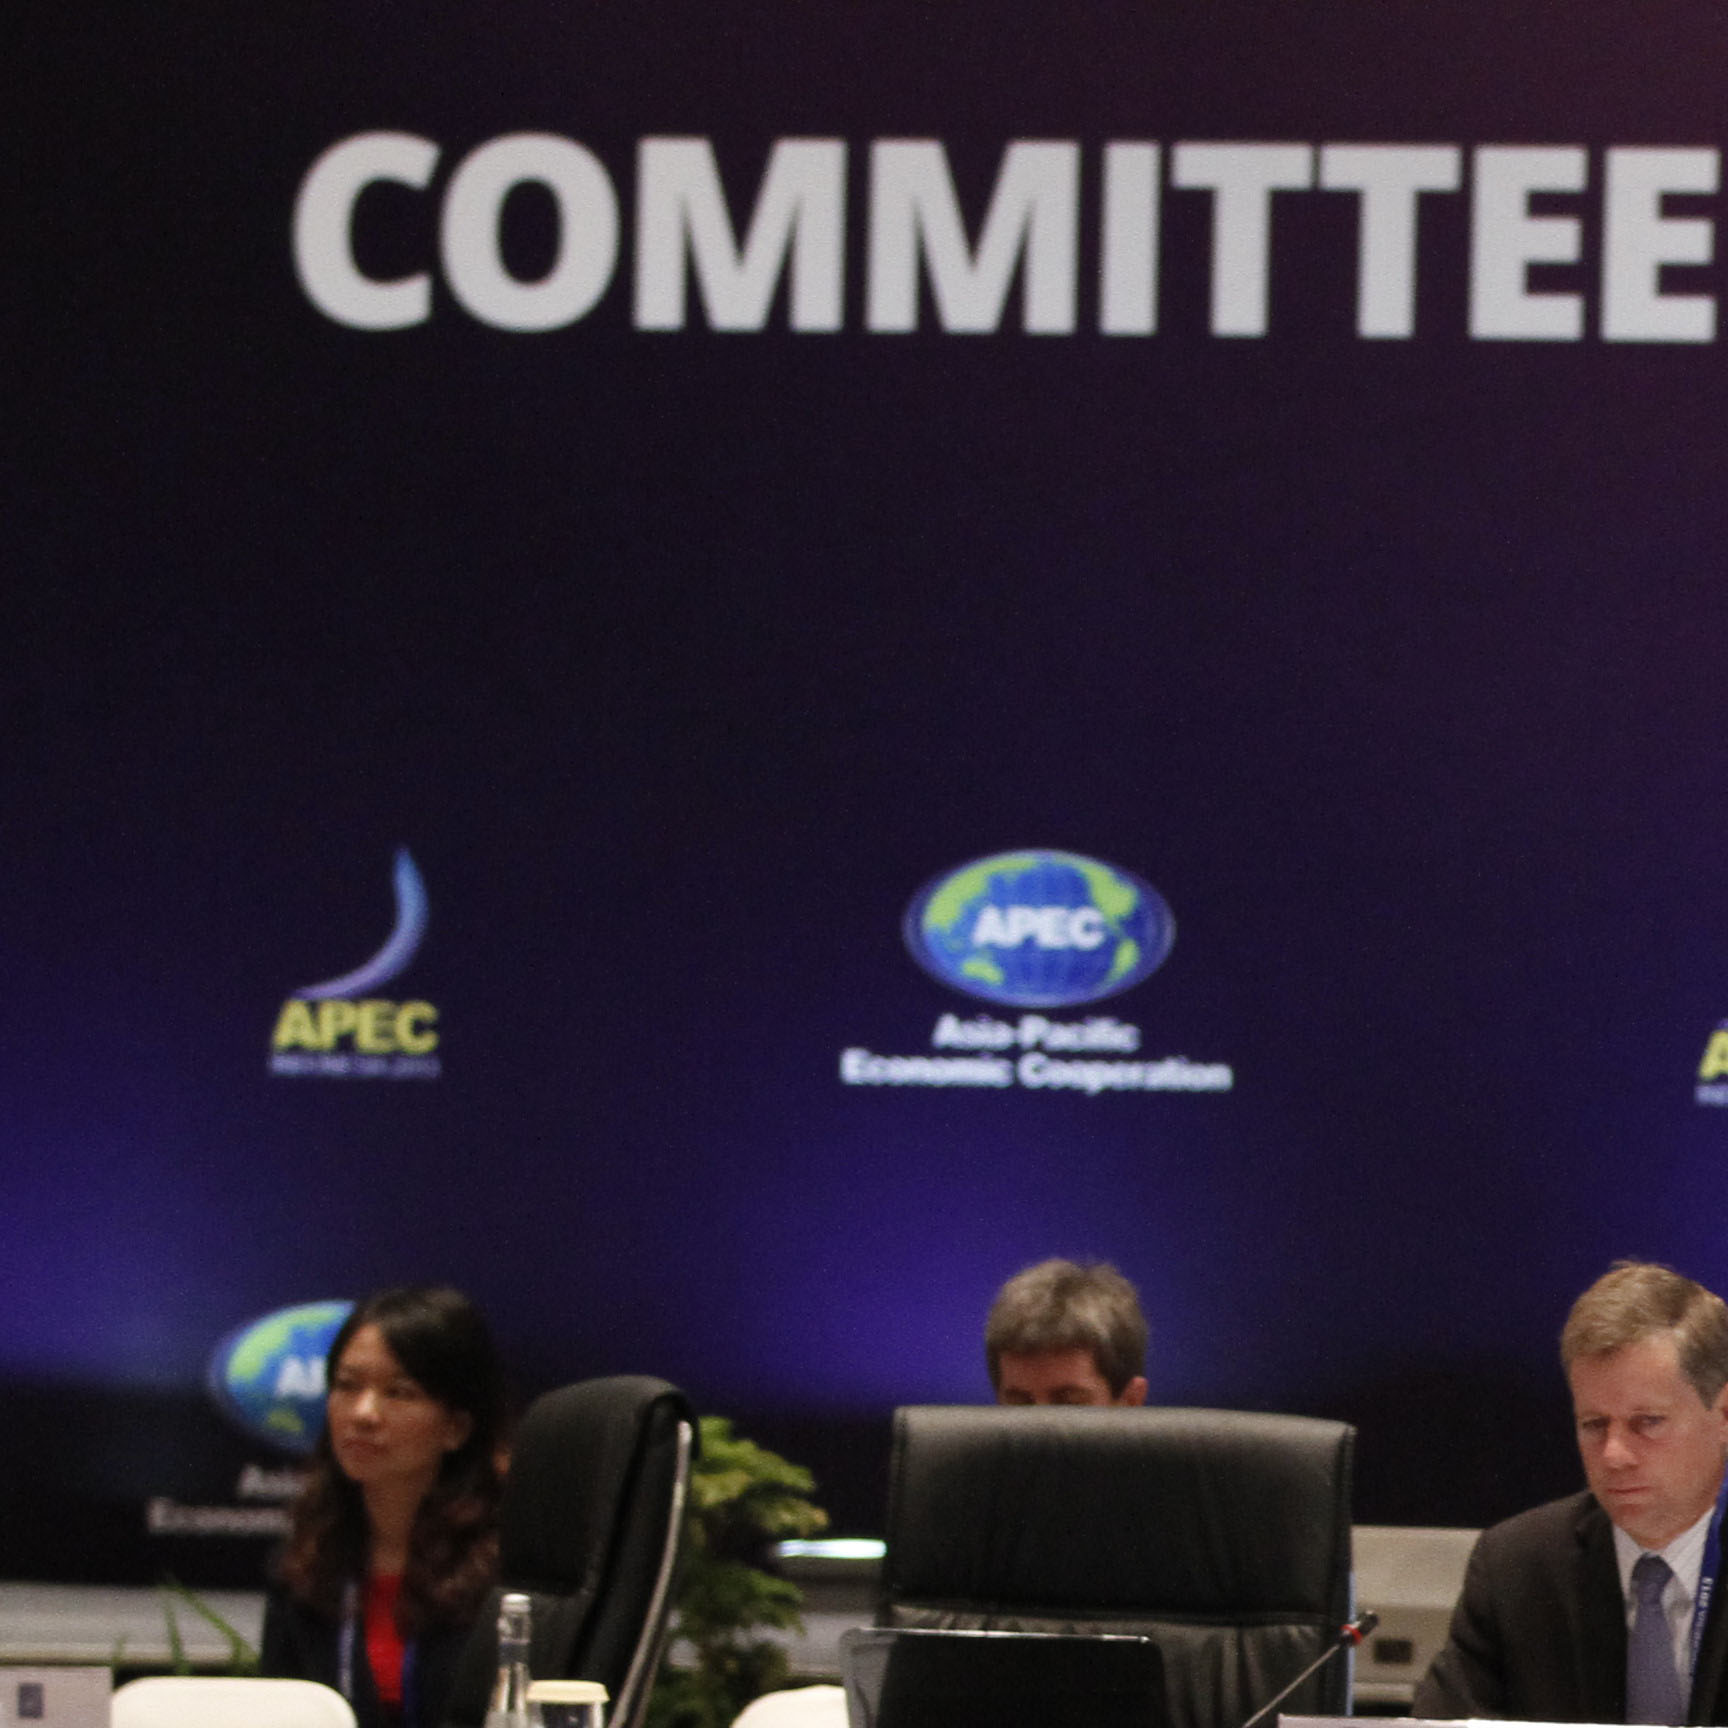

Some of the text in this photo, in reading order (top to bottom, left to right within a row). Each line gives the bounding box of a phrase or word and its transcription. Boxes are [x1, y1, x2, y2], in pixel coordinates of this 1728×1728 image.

[294, 132, 1720, 344] COMMITTEE
[970, 903, 1107, 950] APEC
[271, 998, 440, 1055] APEC
[931, 1013, 1140, 1052] Asia-Pacific
[839, 1047, 1234, 1095] Economic Cooperation
